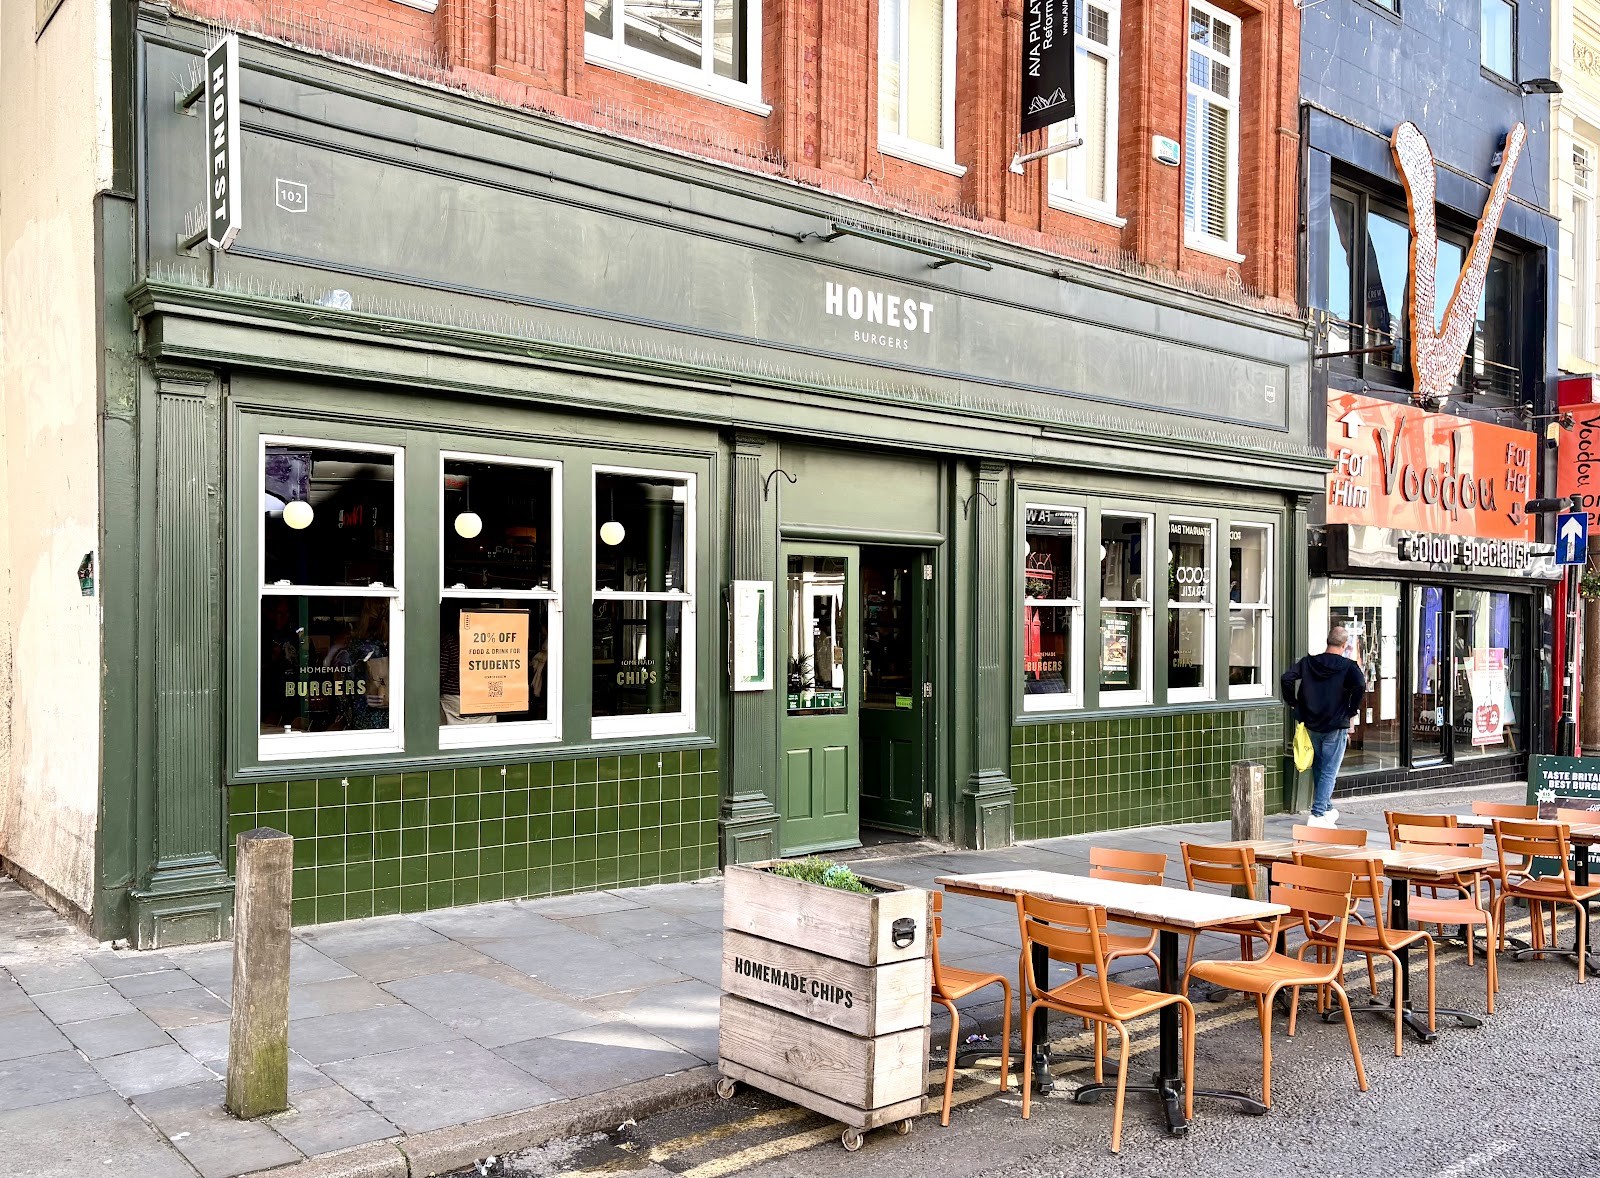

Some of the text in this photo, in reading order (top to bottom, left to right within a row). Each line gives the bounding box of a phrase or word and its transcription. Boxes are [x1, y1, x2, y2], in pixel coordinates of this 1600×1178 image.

[1043, 0, 1053, 50] Reform
[1029, 43, 1041, 77] AVA
[213, 64, 226, 221] HONEST
[280, 189, 303, 204] 102
[825, 281, 934, 334] HONEST
[854, 330, 908, 350] BURGERS
[1337, 447, 1369, 477] For
[1374, 415, 1498, 521] Voodou
[1333, 475, 1370, 509] Him
[473, 632, 517, 643] 20% OFF
[299, 666, 352, 674] HOMEMADE
[468, 659, 521, 671] STUDENTS
[1026, 660, 1063, 672] BURGERS
[616, 670, 657, 686] CHIPS
[285, 680, 366, 697] BURGERS
[1542, 770, 1571, 781] TASTE
[1548, 780, 1571, 790] BEST
[734, 956, 853, 1009] HOMEMADE CHIPS
